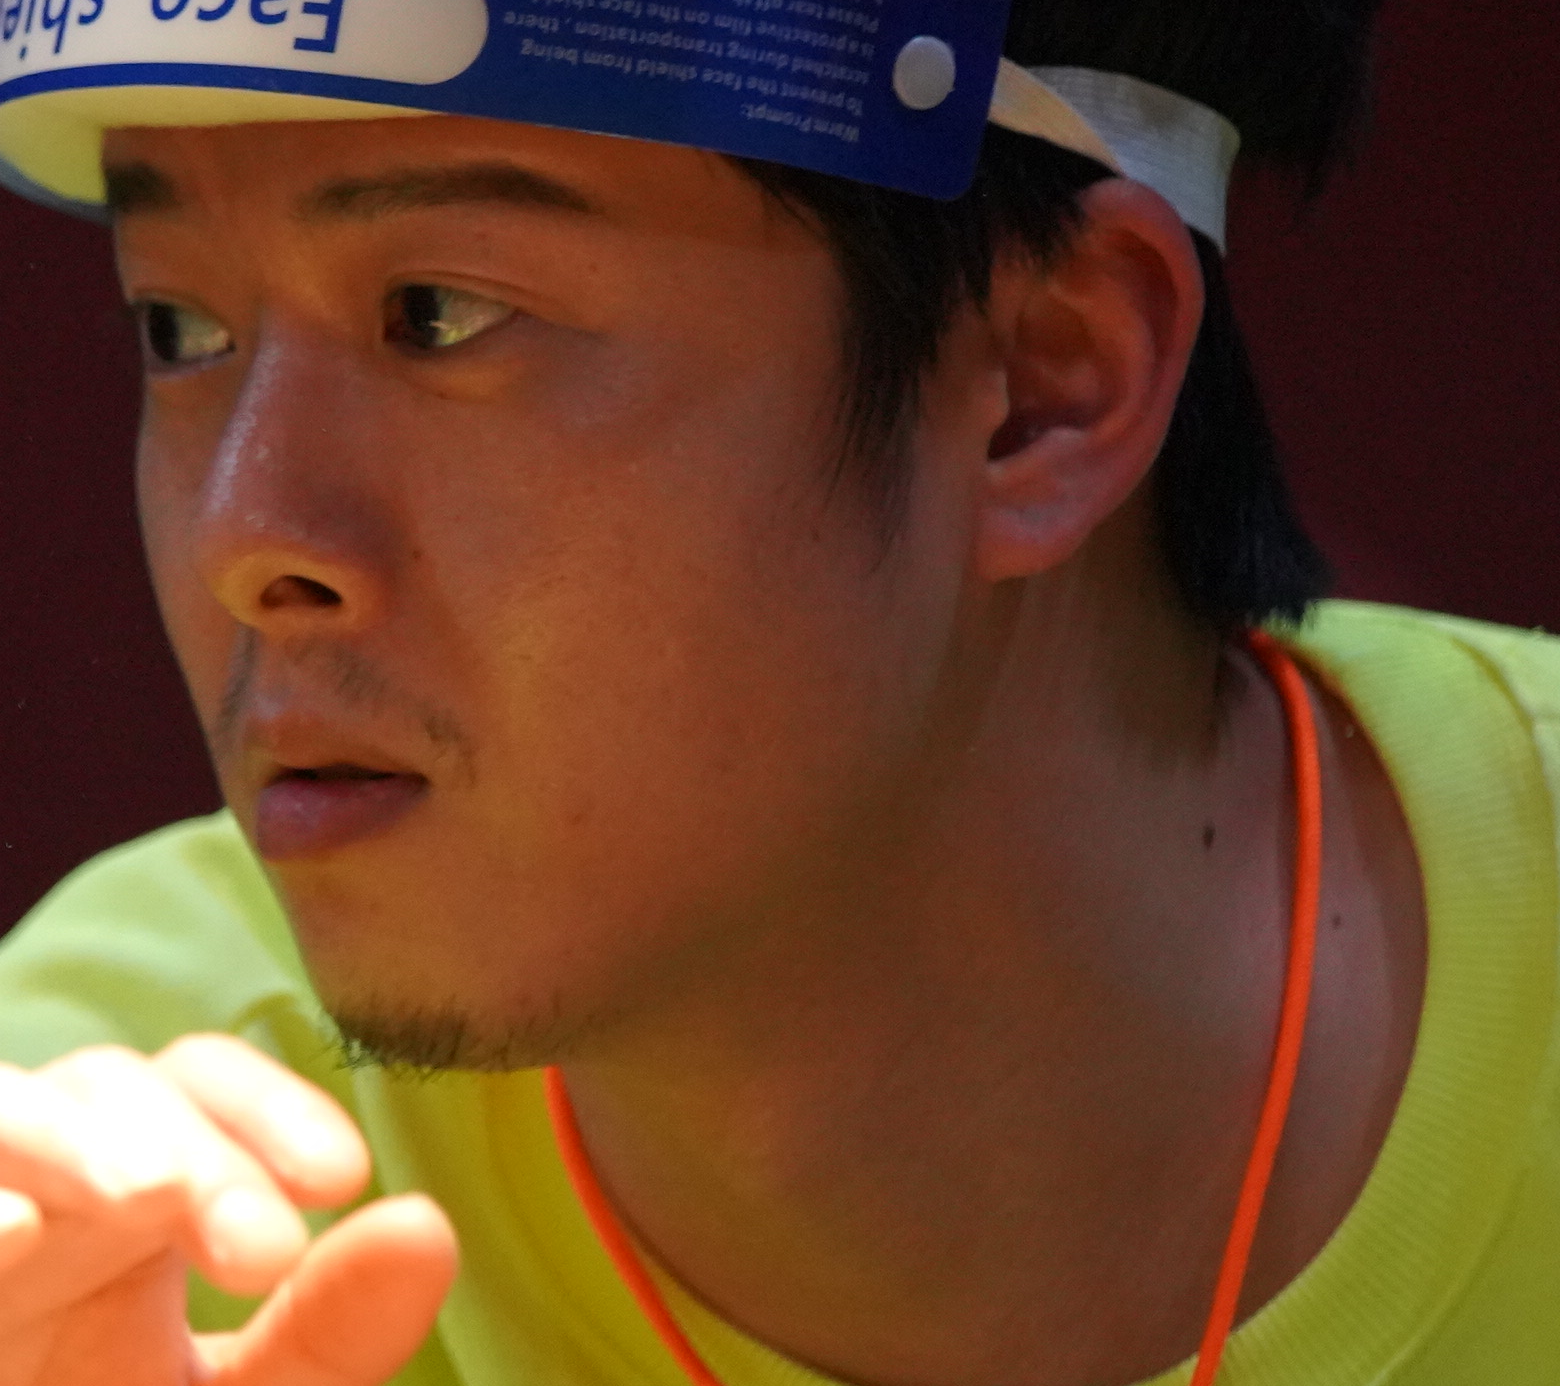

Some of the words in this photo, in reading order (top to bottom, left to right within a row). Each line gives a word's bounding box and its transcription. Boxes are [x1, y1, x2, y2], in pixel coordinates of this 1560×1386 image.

[503, 10, 559, 34] there
[646, 2, 680, 23] the
[683, 9, 711, 24] on
[714, 13, 752, 36] film
[755, 20, 847, 50] protective
[520, 38, 578, 66] being
[582, 50, 632, 74] from
[728, 41, 790, 70] during
[636, 58, 697, 82] shield
[702, 68, 742, 91] face
[746, 76, 778, 96] the
[781, 82, 845, 108] prevent
